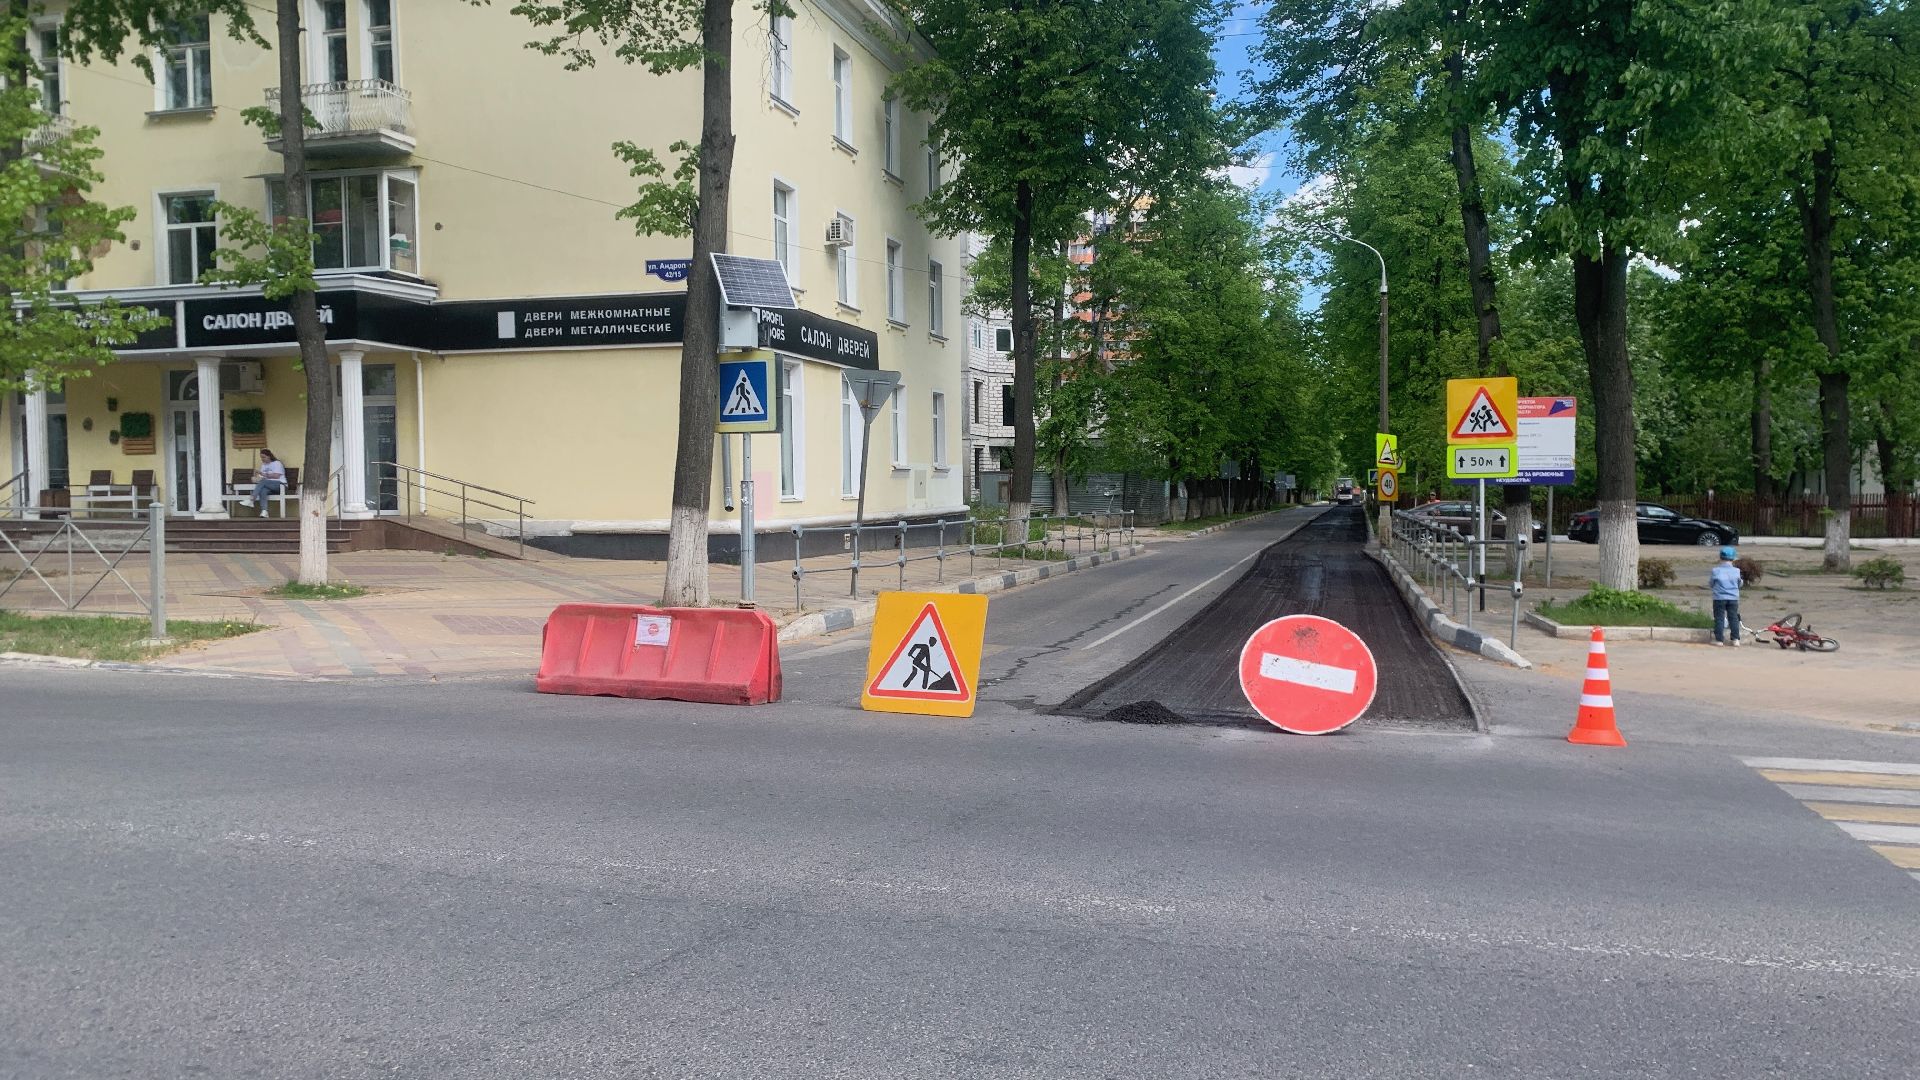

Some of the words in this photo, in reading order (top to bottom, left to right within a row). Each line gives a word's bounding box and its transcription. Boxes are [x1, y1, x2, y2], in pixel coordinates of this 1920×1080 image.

[660, 262, 691, 271] Андроп
[202, 312, 262, 331] САЛОН
[263, 305, 334, 330] ДВЙ
[524, 312, 562, 323] ДВЕРИ
[570, 307, 671, 320] МЕЖКОМНАТНЫЕ
[761, 309, 785, 327] PROFIL
[524, 327, 563, 338] ДВЕРИ
[570, 323, 672, 336] МЕТАЛЛИЧЕСКИЕ
[769, 327, 785, 341] ORS
[801, 325, 832, 349] САЛОН
[837, 336, 870, 358] ДВЕРЕЙ
[1384, 480, 1392, 489] 40
